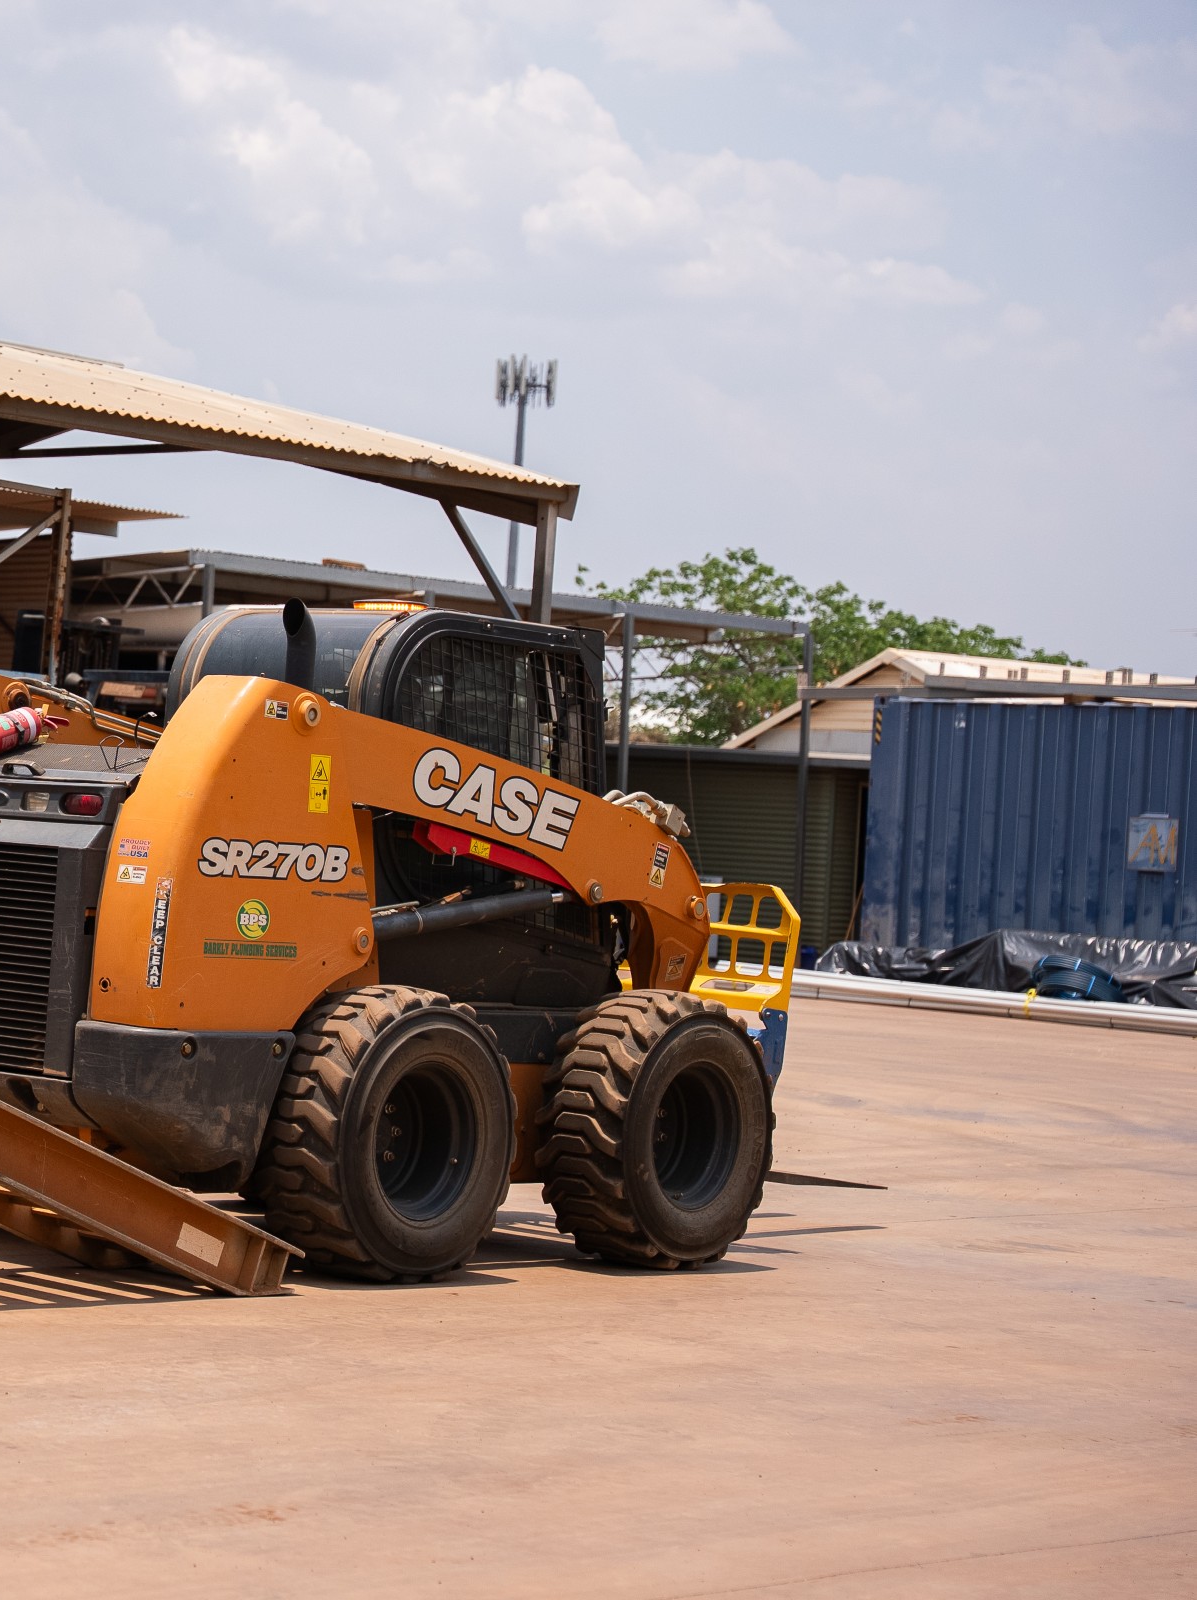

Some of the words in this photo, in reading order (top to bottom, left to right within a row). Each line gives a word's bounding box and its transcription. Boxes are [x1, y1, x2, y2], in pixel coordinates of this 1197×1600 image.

[412, 746, 581, 851] CASE
[130, 850, 148, 858] USA
[198, 836, 350, 883] SR270B
[239, 913, 268, 927] BPS
[149, 935, 163, 986] CLEAR
[203, 941, 230, 955] BARKLY
[231, 943, 265, 957] PLUMBING
[266, 944, 298, 958] SERVICES
